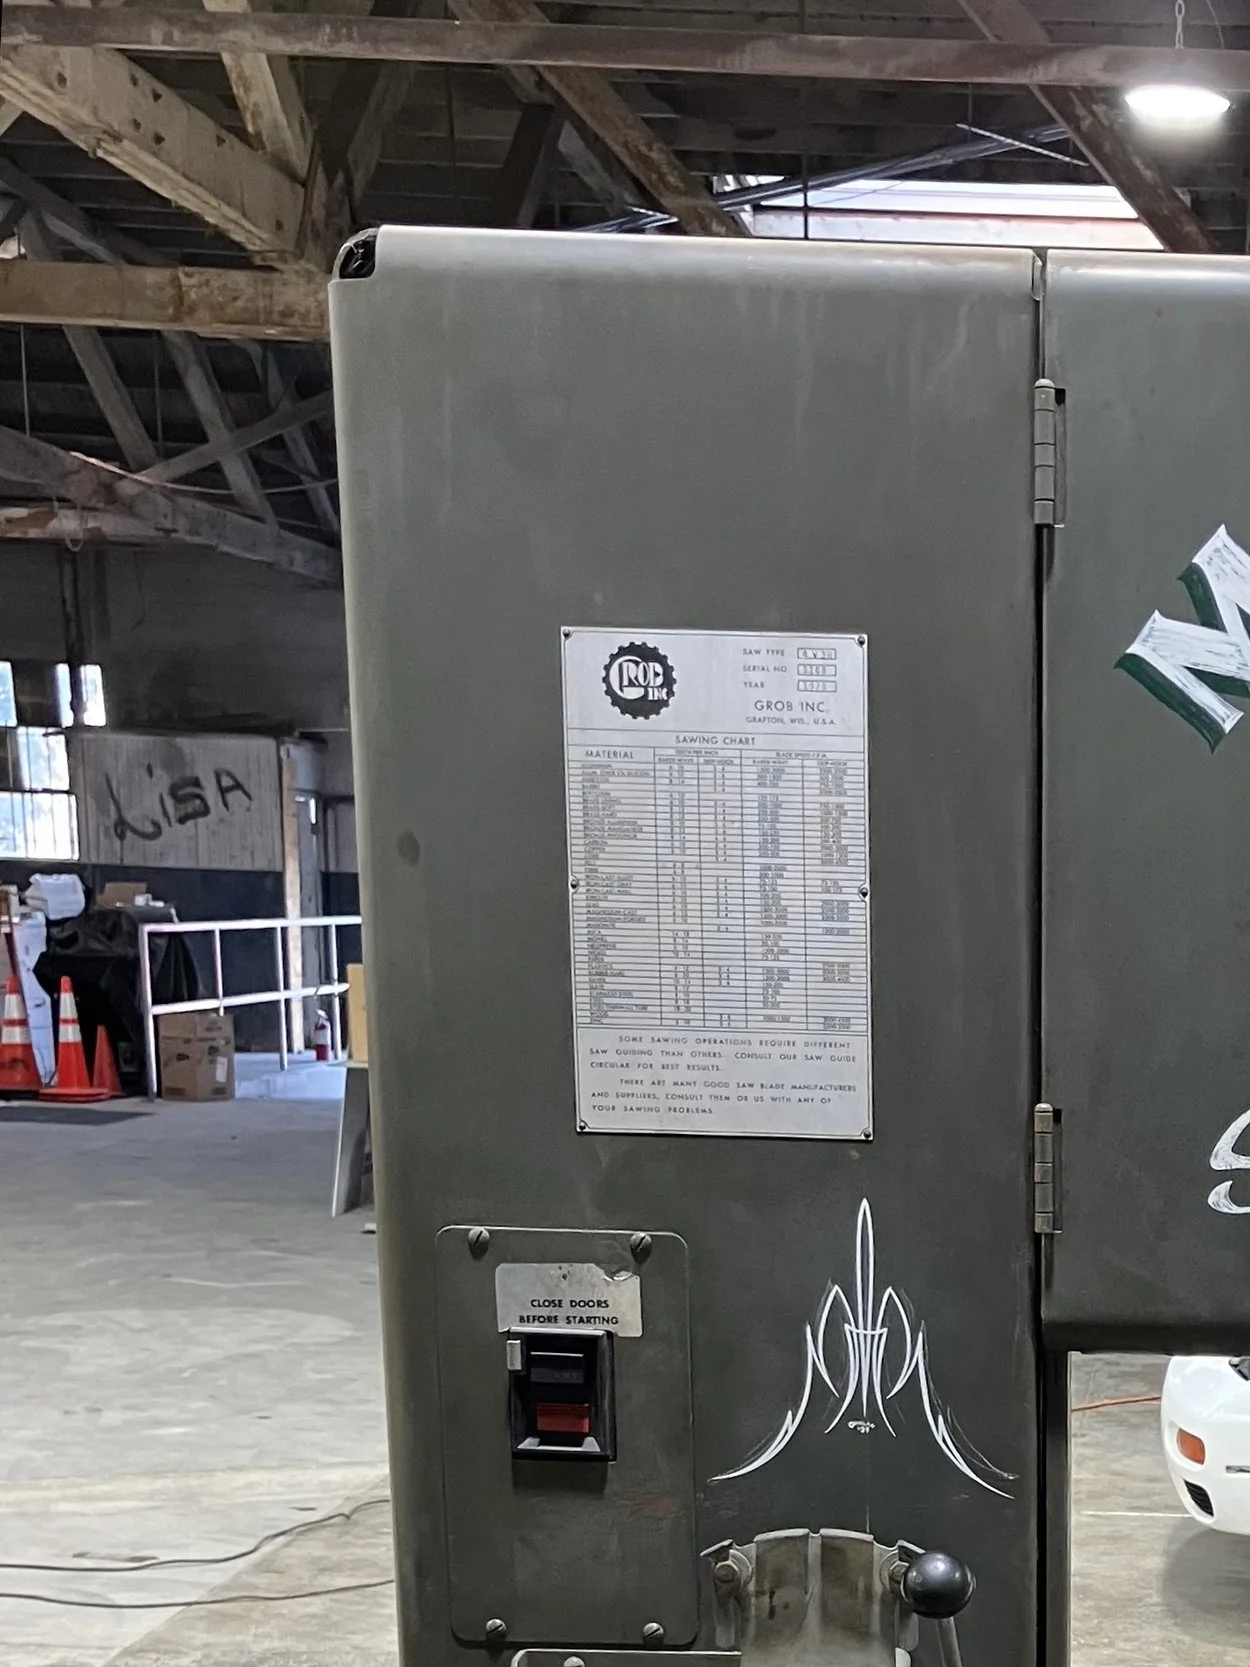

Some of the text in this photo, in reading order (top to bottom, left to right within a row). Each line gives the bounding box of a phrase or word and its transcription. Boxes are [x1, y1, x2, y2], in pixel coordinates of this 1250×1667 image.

[742, 648, 762, 656] SAW
[765, 648, 785, 657] TYPE
[742, 665, 770, 673] SERIAL
[743, 681, 765, 689] YEAR
[754, 700, 830, 713] GROB INC.
[675, 735, 756, 746] SAWING CHART
[585, 749, 634, 760] MATERIAL
[618, 1035, 851, 1049] SOME SAWING OPERATIONS REQUIRE DIFFERENT
[615, 1048, 653, 1056] GUIDING
[660, 1049, 684, 1057] THAN
[734, 1052, 772, 1060] CONSULT
[779, 1053, 798, 1061] OUR
[829, 1055, 857, 1063] GUIDE
[590, 1061, 630, 1069] CIRCULAR
[619, 1078, 645, 1086] THERE
[703, 1080, 730, 1088] GOOD
[790, 1084, 857, 1092] MANUFACTURERS
[665, 1093, 704, 1101] CONSULT
[708, 1094, 731, 1102] THEM
[753, 1095, 765, 1103] US
[770, 1096, 792, 1104] WITH
[591, 1104, 616, 1112] YOUR
[623, 1105, 661, 1114] SAWING
[530, 1299, 610, 1309] CLOSE DOORS
[519, 1315, 620, 1326] BEFORE STARTING
